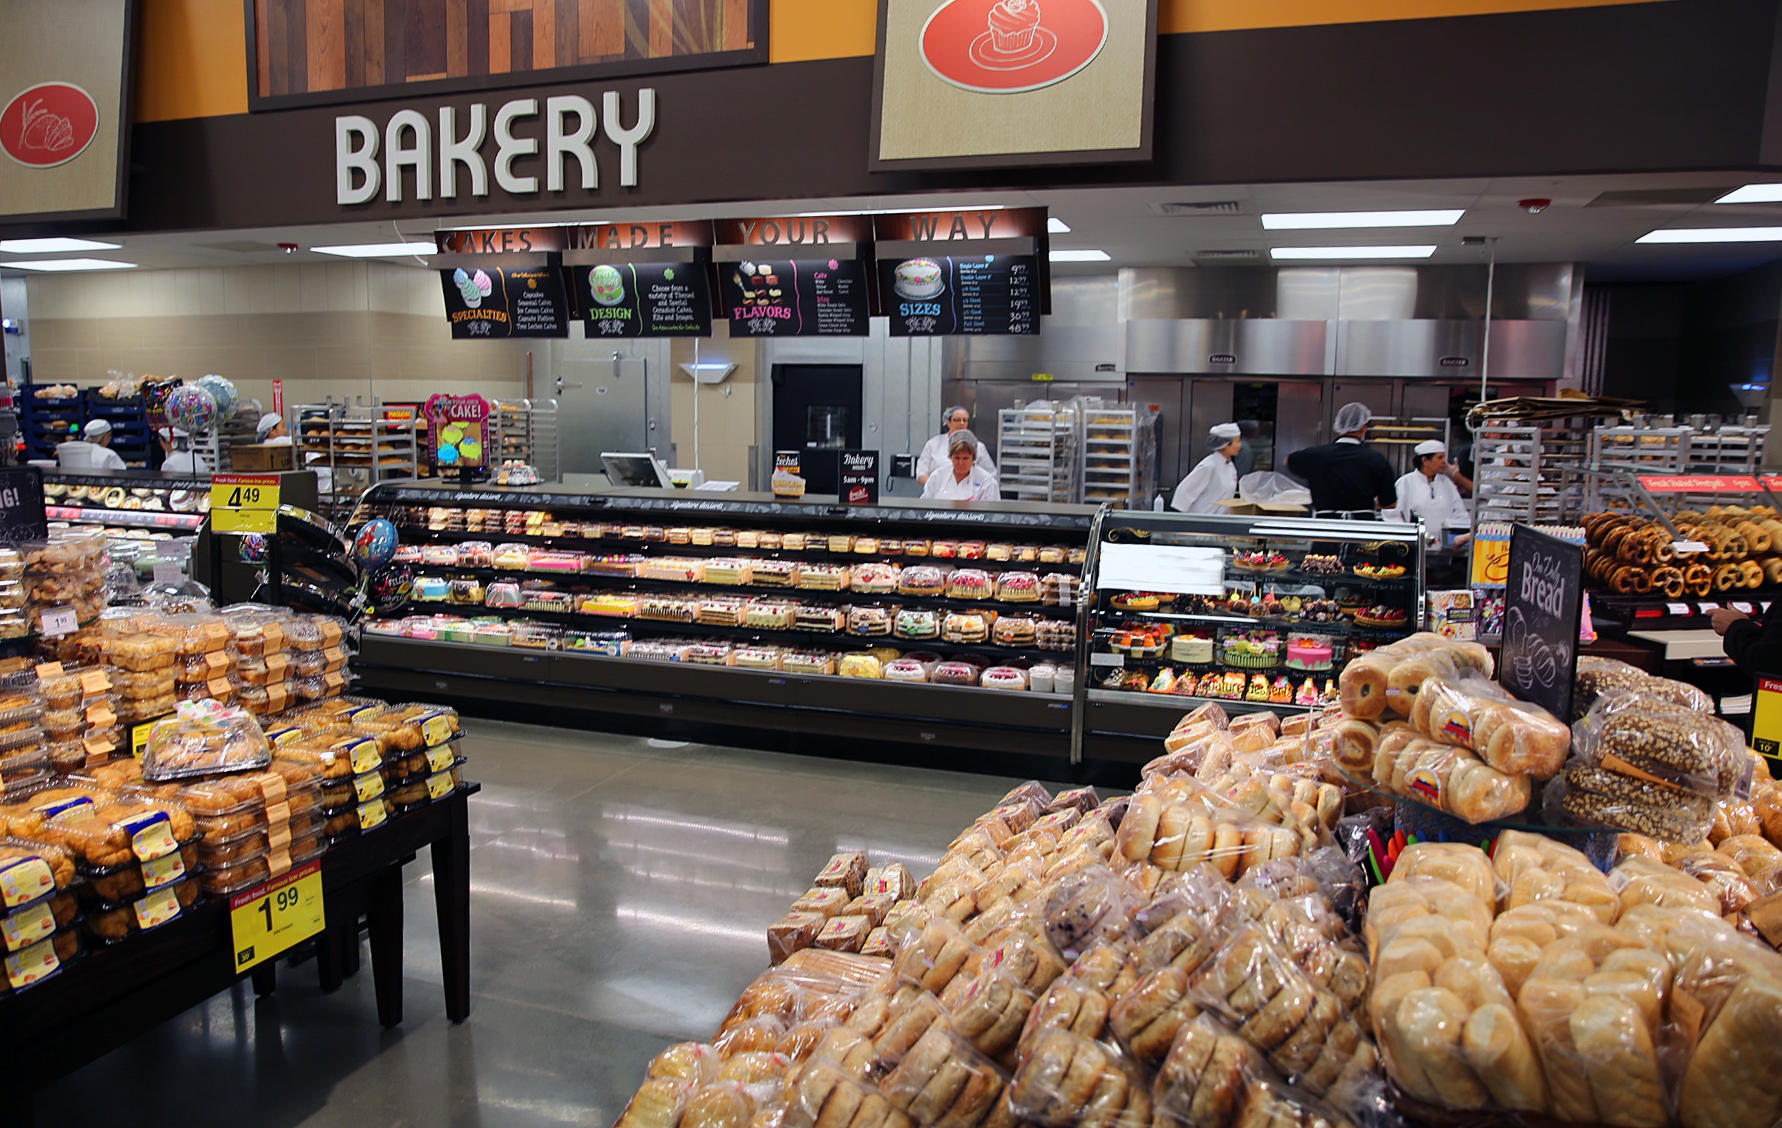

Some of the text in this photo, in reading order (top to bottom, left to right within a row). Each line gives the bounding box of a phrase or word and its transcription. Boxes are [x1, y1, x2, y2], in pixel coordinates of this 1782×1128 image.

[336, 88, 656, 205] BAKERY
[442, 213, 997, 253] CAKES MADE YOUR WAY
[651, 284, 671, 292] Choose
[452, 309, 508, 324] SPECIALTIES
[590, 308, 632, 320] DESIGN
[733, 306, 792, 320] FLAVORS
[899, 303, 941, 316] SIZES
[451, 404, 481, 418] CAKE!
[843, 453, 874, 469] Bakery
[861, 476, 874, 485] 9pm
[455, 491, 501, 502] signature desserts
[670, 500, 723, 511] signature desserts
[924, 509, 985, 521] signature desserts
[1521, 561, 1565, 620] Bread
[234, 895, 252, 907] Fresh
[267, 878, 288, 892] Famous
[288, 873, 299, 882] low
